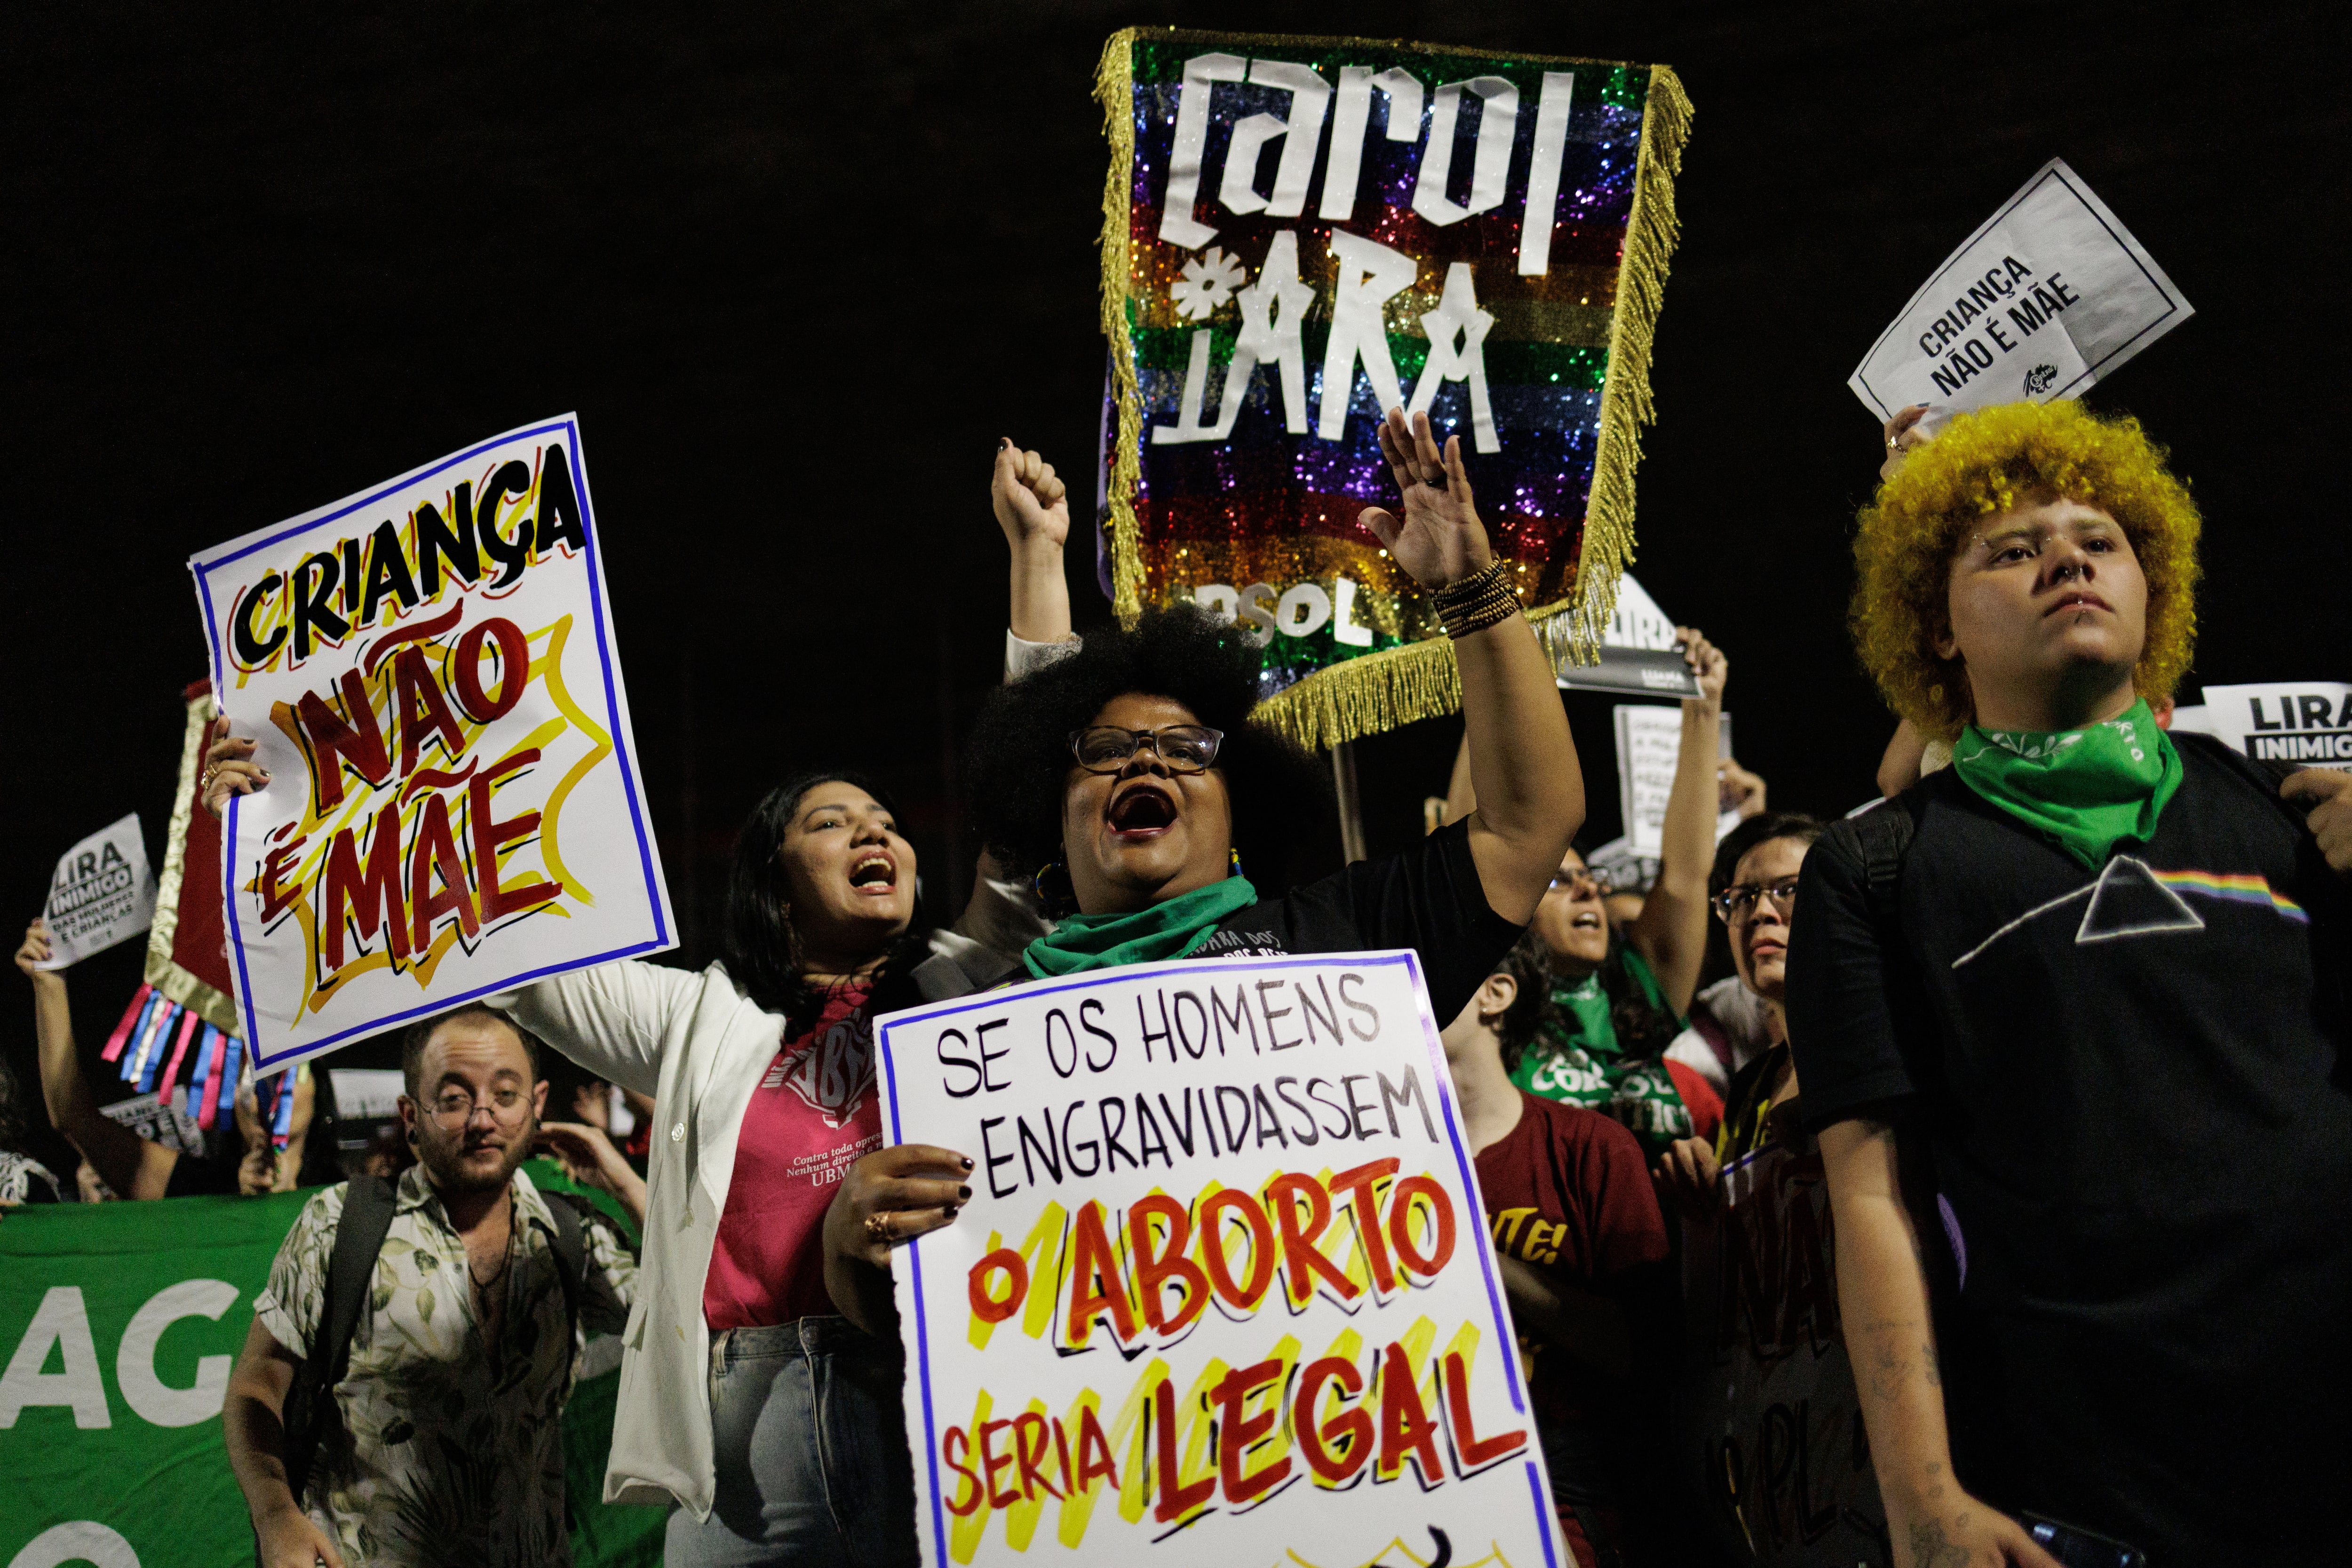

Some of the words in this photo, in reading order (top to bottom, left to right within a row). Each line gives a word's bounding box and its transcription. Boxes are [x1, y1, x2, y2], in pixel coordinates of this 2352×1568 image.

[1919, 256, 2032, 358] CRIANÇA
[1930, 341, 1994, 397] NÃO
[1985, 317, 2018, 354] É
[2007, 272, 2080, 336] MÃE
[234, 444, 587, 664] CRIANÇA
[299, 598, 530, 812] NÃO
[52, 868, 129, 915] INIMIGO
[55, 841, 123, 891] LIRA
[261, 821, 306, 923] É
[326, 748, 562, 971] MÃE
[938, 1018, 1010, 1098] SE
[1046, 998, 1117, 1077] OS
[1137, 972, 1381, 1064] HOMENS
[787, 1161, 829, 1178] Nenhum
[832, 1149, 865, 1167] direito
[793, 1152, 828, 1166] Contra
[831, 1143, 853, 1157] toda
[811, 1162, 851, 1187] UBM
[980, 1063, 1438, 1199] ENGRAVIDASSEM
[968, 1248, 1029, 1323] O
[1068, 1156, 1456, 1343] ABORTO
[943, 1404, 1120, 1516] SERIA
[1154, 1341, 1527, 1523] LEGAL
